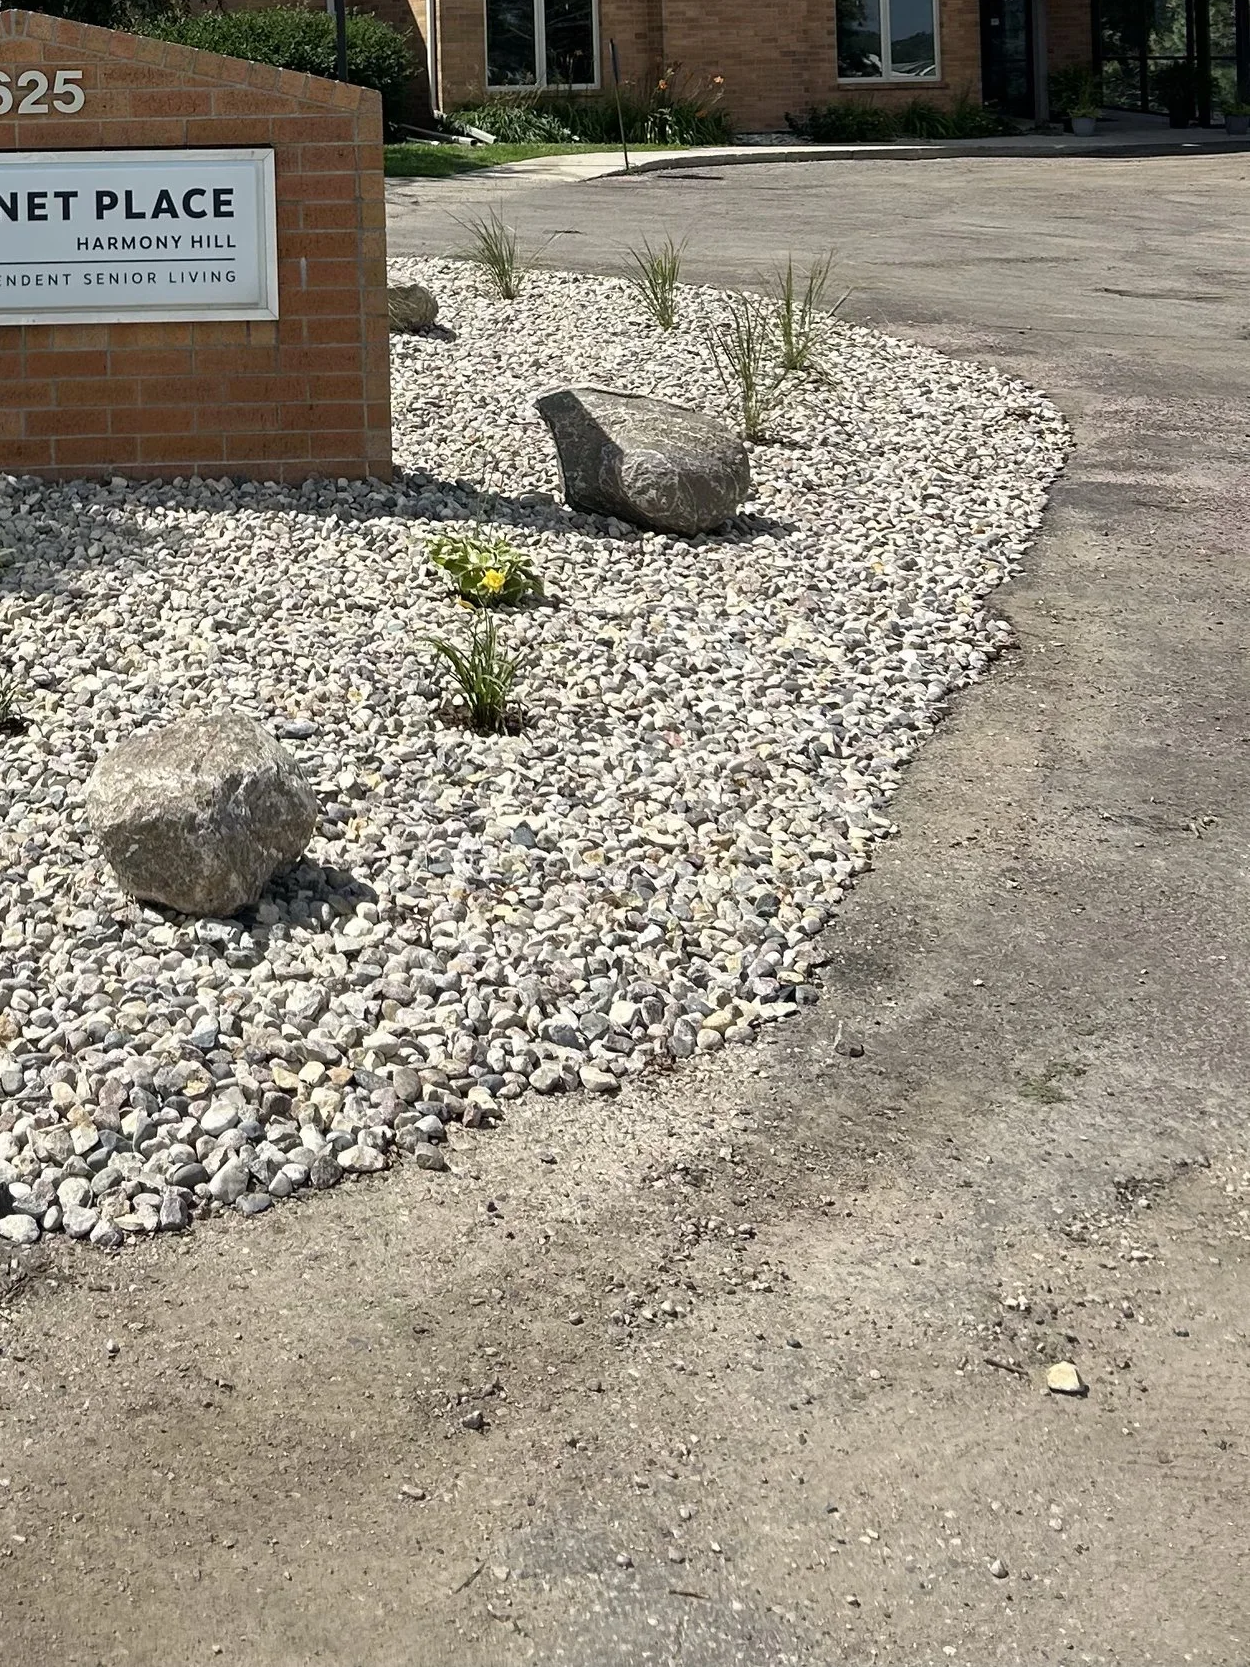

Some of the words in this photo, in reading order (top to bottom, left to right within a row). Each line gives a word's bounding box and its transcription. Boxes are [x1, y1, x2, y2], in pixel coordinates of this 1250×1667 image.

[95, 188, 235, 221] PLACE
[76, 235, 182, 252] HARMONY
[190, 234, 237, 249] HILL
[83, 272, 157, 286] SENIOR
[168, 270, 236, 284] LIVING
